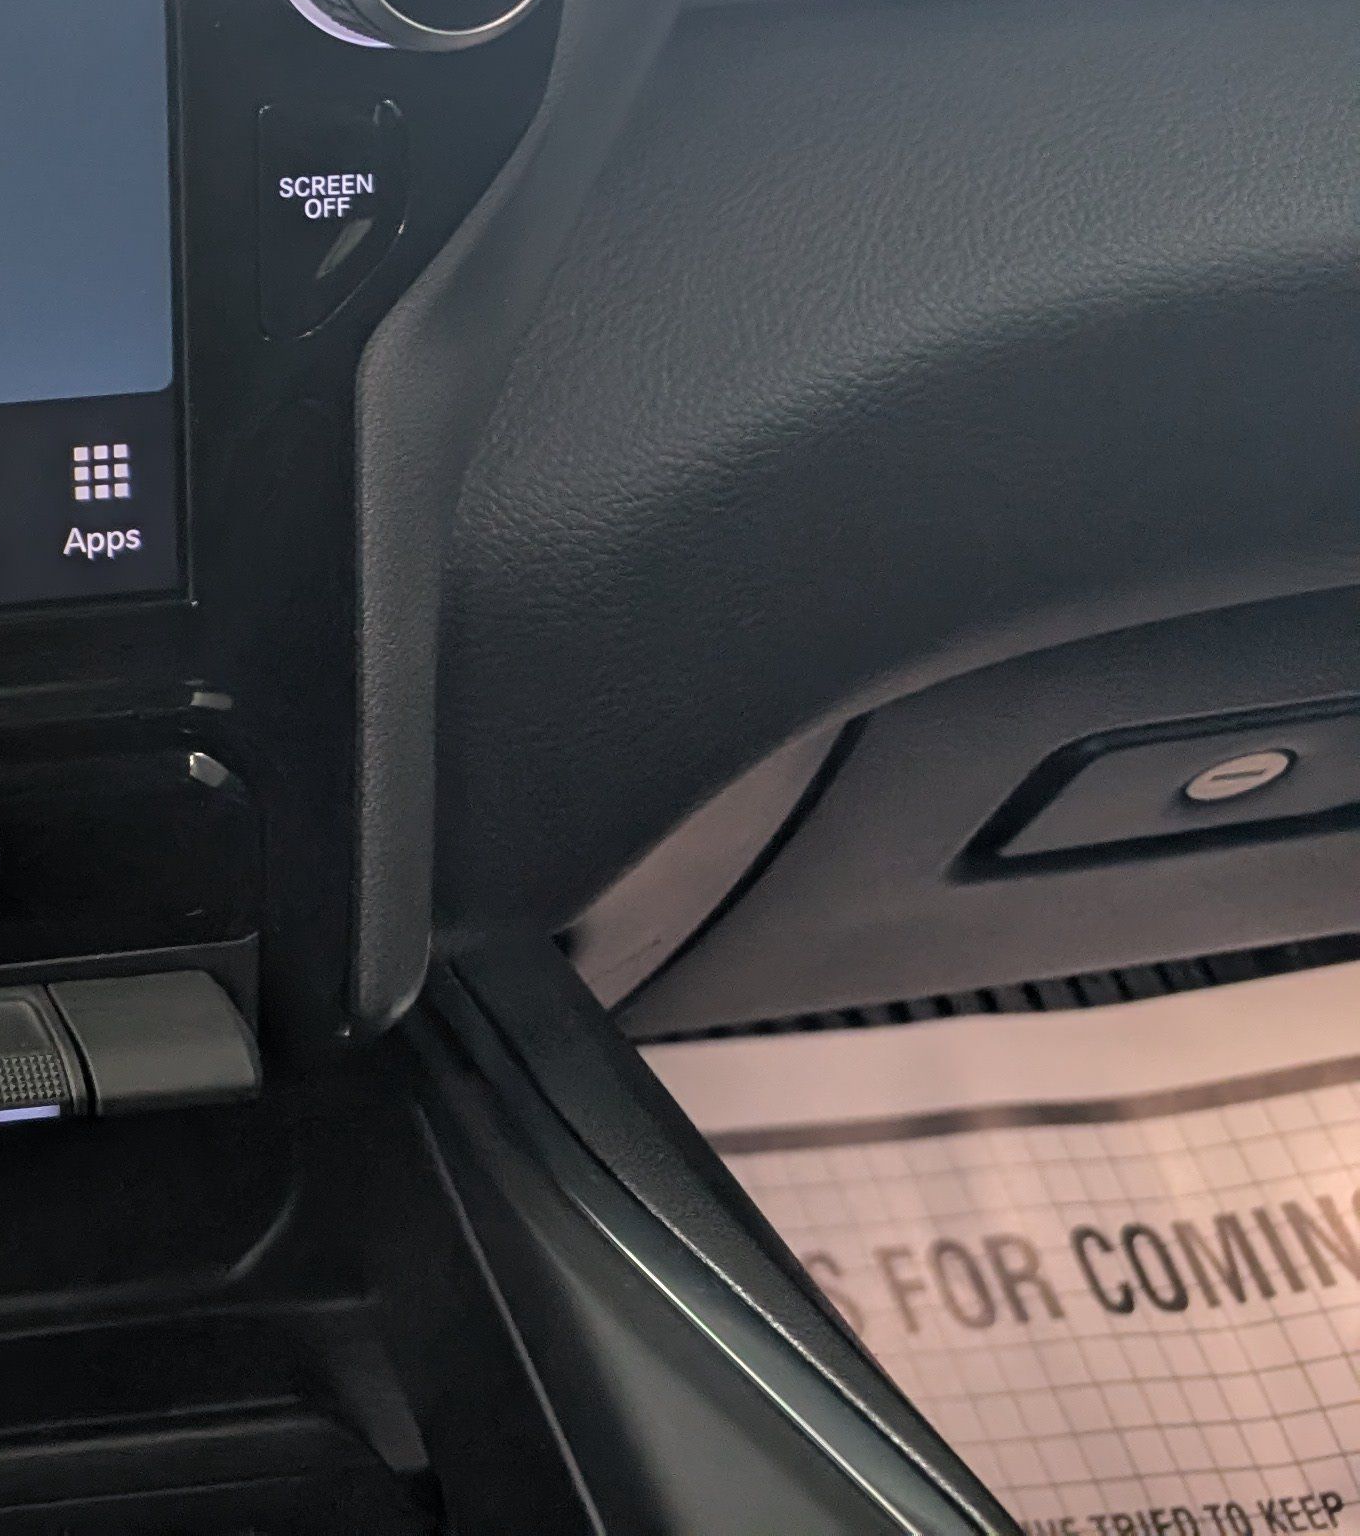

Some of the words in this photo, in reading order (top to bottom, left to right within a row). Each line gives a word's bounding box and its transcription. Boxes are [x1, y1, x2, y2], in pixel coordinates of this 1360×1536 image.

[279, 173, 374, 199] SCREEN
[304, 197, 350, 219] OFF
[63, 525, 142, 562] Apps
[872, 1231, 1066, 1335] FOR
[1069, 1188, 1360, 1316] COMIN
[1203, 1502, 1253, 1536] TO
[1256, 1491, 1345, 1533] KEEP
